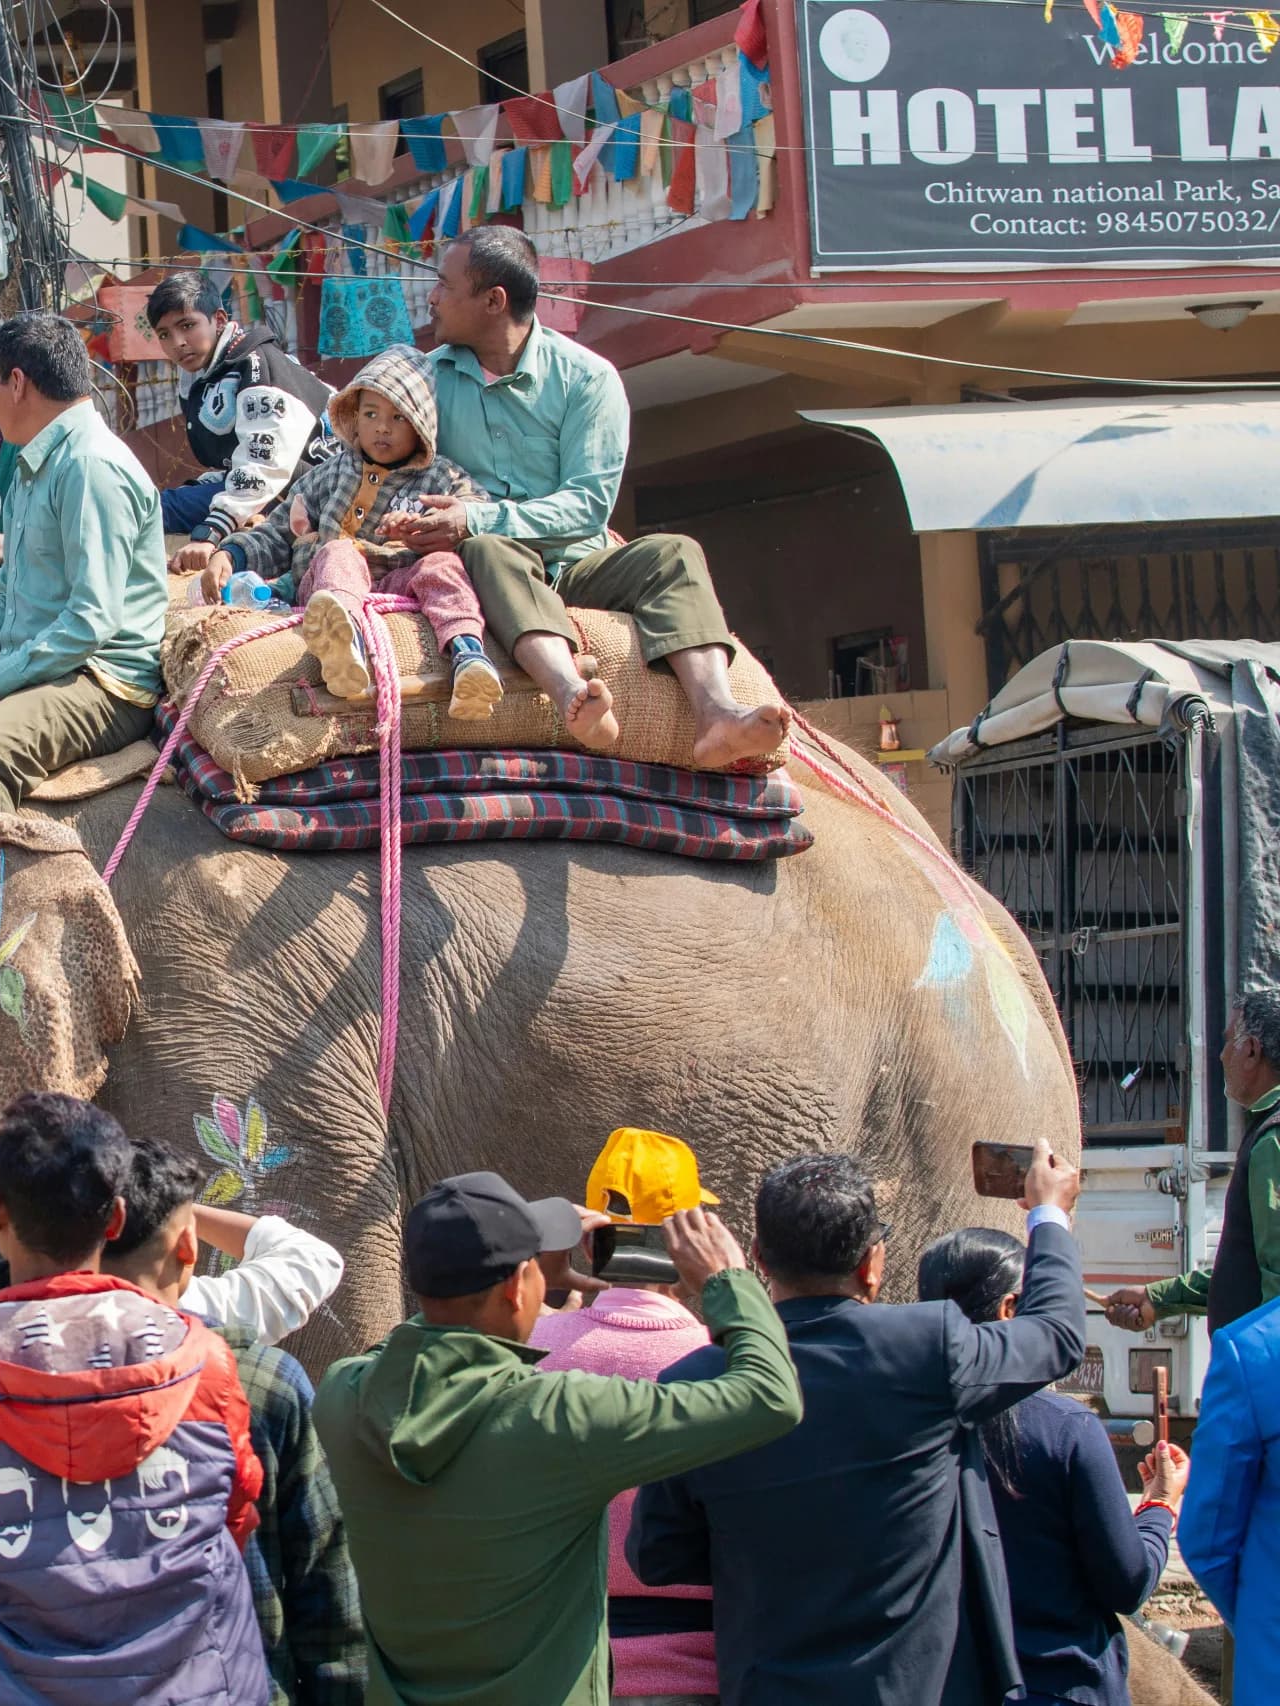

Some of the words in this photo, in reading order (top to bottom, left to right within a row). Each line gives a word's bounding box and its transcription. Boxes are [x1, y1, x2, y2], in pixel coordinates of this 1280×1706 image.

[830, 87, 1152, 165] HOTEL
[1176, 86, 1280, 161] LA
[924, 181, 1043, 204] Chitwan
[1052, 180, 1163, 204] national
[1173, 179, 1241, 204] Park,
[970, 213, 1086, 235] Contact:
